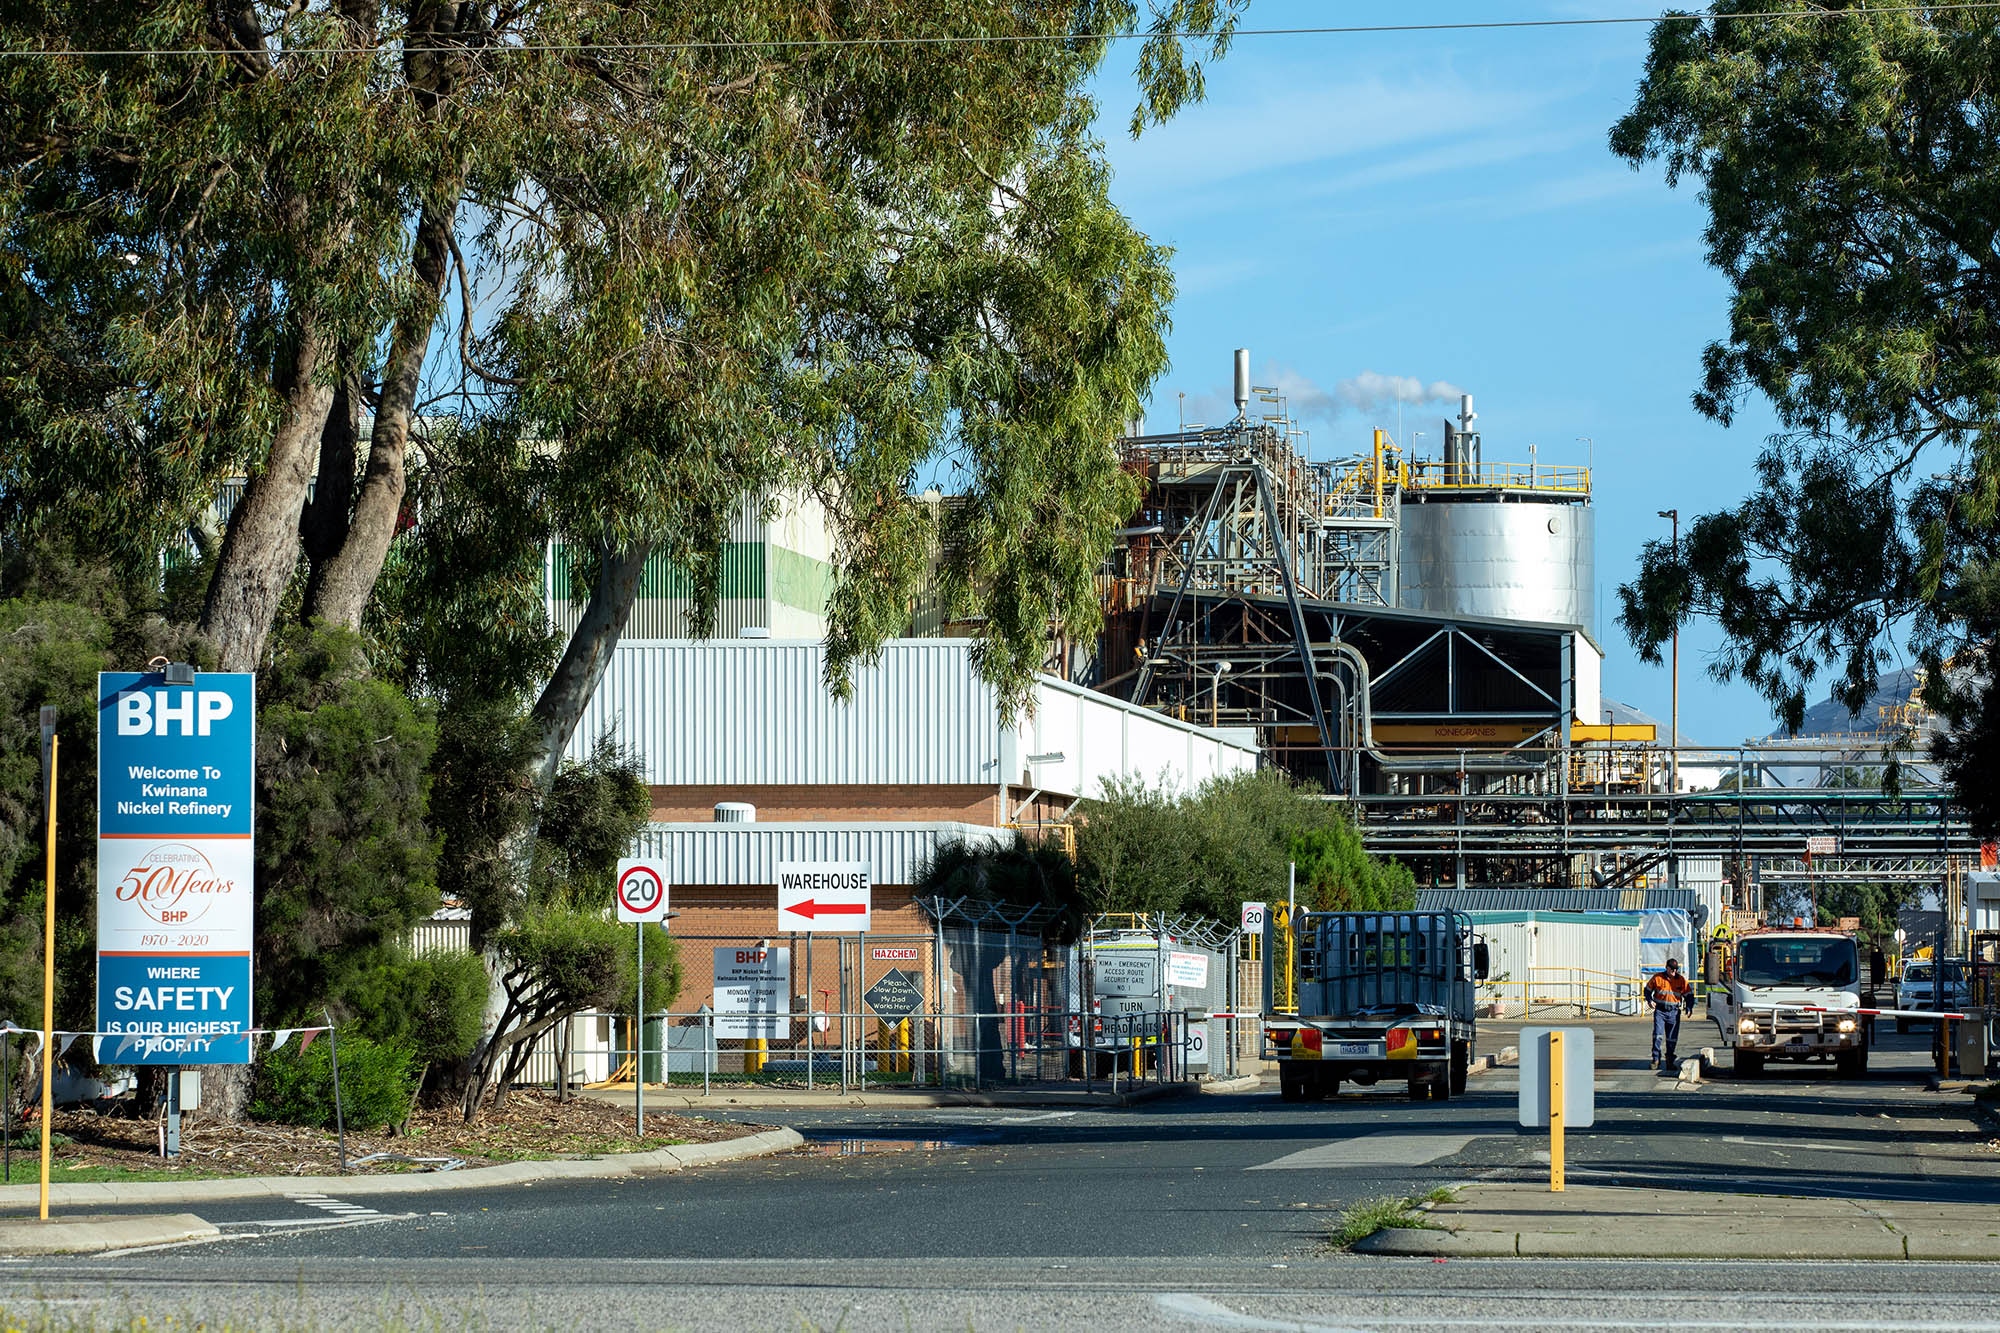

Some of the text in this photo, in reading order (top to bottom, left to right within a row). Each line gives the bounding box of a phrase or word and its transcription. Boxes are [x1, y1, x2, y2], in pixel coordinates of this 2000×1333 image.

[118, 691, 233, 736] BHP
[1434, 728, 1496, 737] KONECRANES
[128, 766, 221, 779] Welcome To
[142, 784, 207, 797] Kwinana
[117, 801, 232, 818] Nickel Refinery
[150, 854, 200, 863] CELEBRATING
[116, 865, 234, 910] 50 Years
[782, 873, 867, 890] WAREHOUSE
[626, 878, 655, 901] 20
[162, 911, 188, 922] BHP
[1246, 912, 1262, 923] 20
[141, 935, 168, 946] 1970
[177, 935, 209, 946] 2020
[735, 951, 768, 963] BHP
[874, 949, 916, 959] HAZCHEM
[147, 968, 201, 979] WHERE
[114, 986, 234, 1011] SAFETY
[1120, 1002, 1143, 1011] TURN
[107, 1021, 241, 1035] IS OUR HIGHEST
[1185, 1037, 1203, 1051] 20
